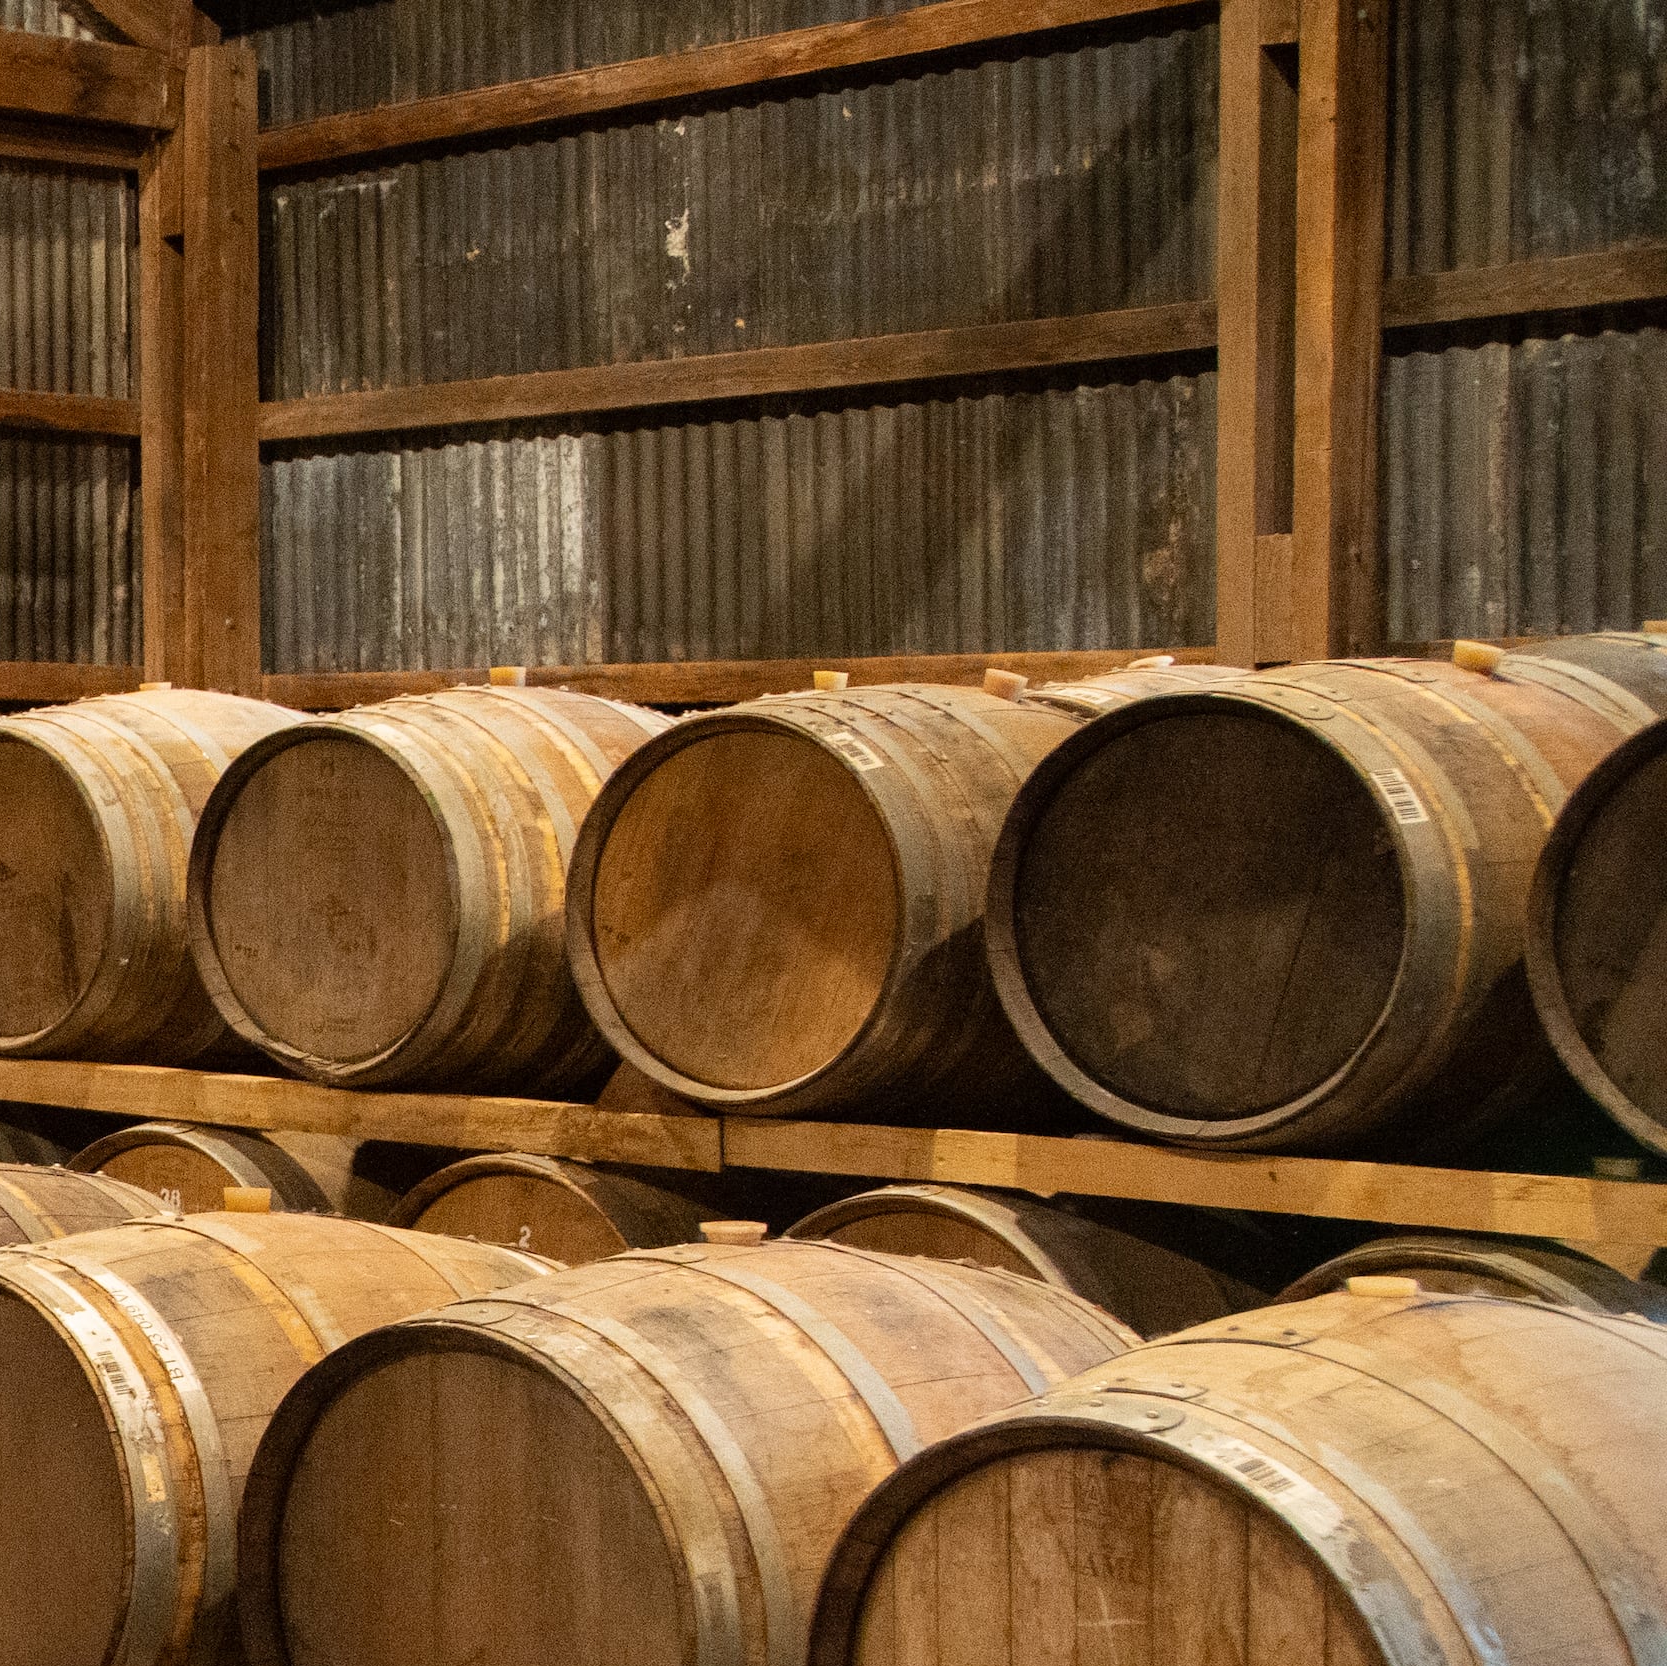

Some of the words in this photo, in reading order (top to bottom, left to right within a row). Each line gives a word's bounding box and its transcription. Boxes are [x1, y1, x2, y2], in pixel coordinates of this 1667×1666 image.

[518, 1225, 532, 1249] 2
[126, 1304, 153, 1330] 049
[149, 1333, 170, 1351] 23
[165, 1359, 185, 1380] BT
